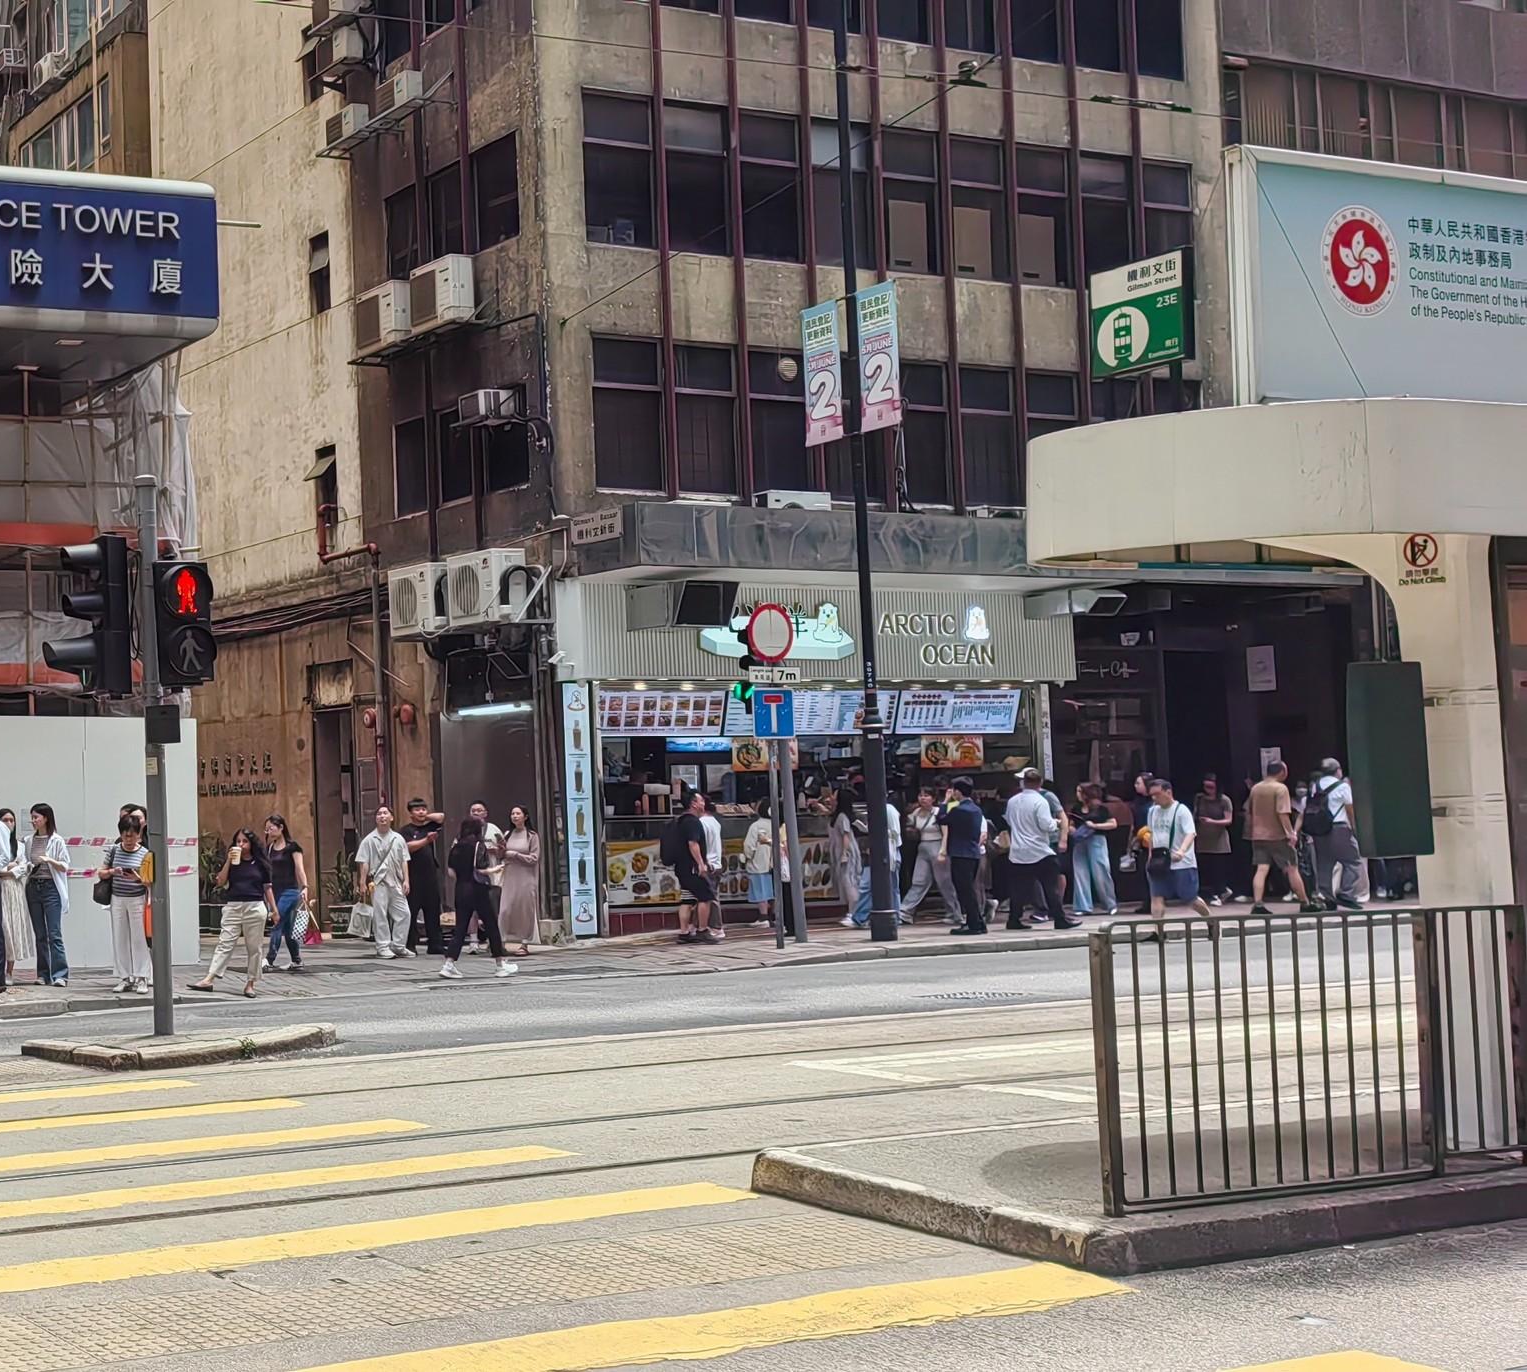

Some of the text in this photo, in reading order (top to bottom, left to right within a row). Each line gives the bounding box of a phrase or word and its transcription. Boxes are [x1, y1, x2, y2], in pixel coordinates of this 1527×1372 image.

[53, 203, 181, 240] TOWER
[1407, 216, 1527, 246] 中華人民共和國香港
[1127, 274, 1177, 292] Gilman Street
[1409, 266, 1477, 286] Constitutional
[1480, 276, 1498, 288] and
[1156, 293, 1178, 308] 23E
[1410, 285, 1429, 299] The
[1431, 287, 1489, 305] Government
[1492, 293, 1501, 306] of
[1504, 295, 1518, 308] the
[1411, 304, 1526, 326] of the People's Republic
[864, 351, 894, 405] 2
[809, 369, 838, 421] 2
[1398, 578, 1409, 586] Do
[878, 613, 957, 636] ARCTIC
[921, 643, 996, 667] OCEAN
[777, 670, 796, 681] 7m
